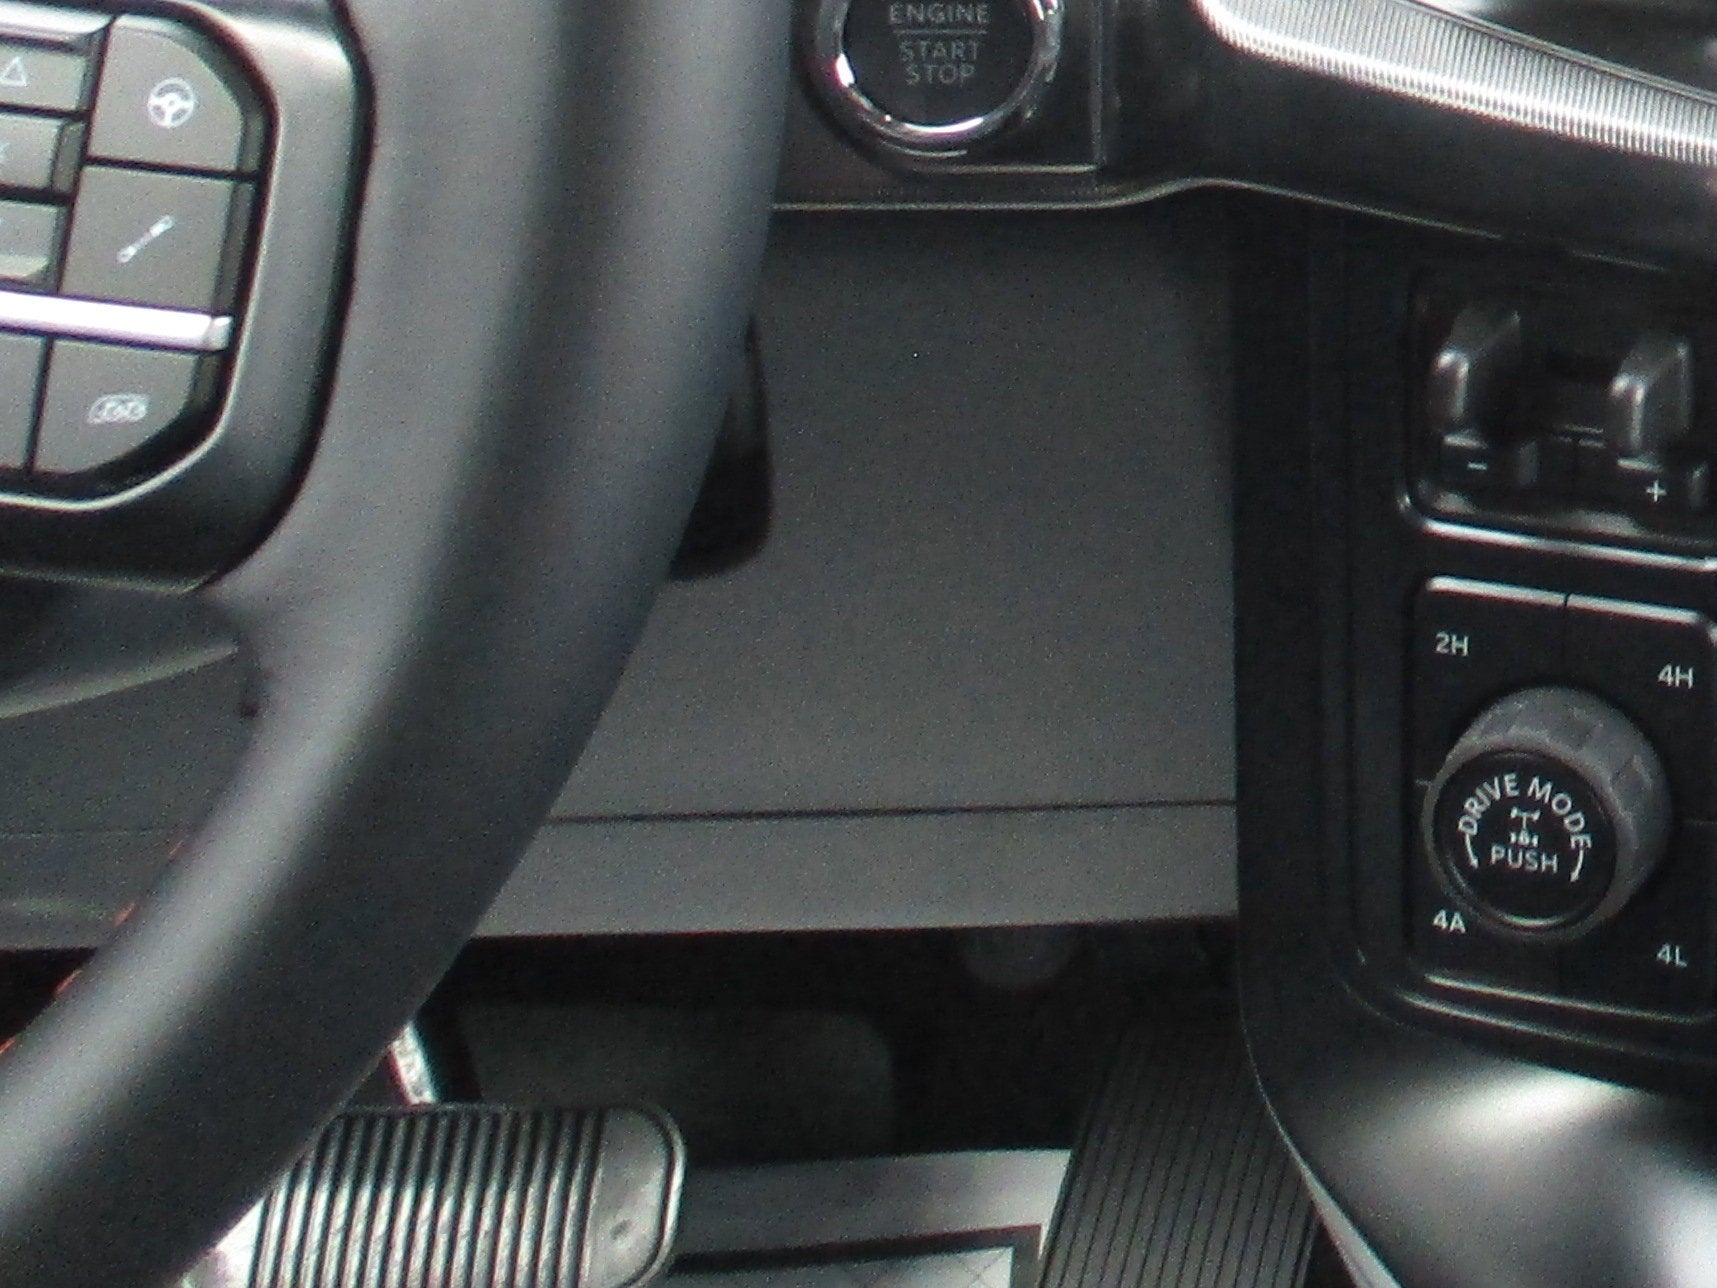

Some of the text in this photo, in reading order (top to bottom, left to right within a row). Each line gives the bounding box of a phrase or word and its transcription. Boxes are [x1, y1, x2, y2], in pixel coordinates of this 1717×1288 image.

[889, 2, 990, 25] ENGINE
[899, 40, 978, 62] START
[905, 64, 975, 86] STOP
[1434, 632, 1470, 658] 2H
[1657, 664, 1695, 690] 4H
[1458, 773, 1592, 849] DRIVE MODE
[1490, 844, 1558, 873] PUSH
[1432, 908, 1467, 935] 4A
[1655, 943, 1690, 970] 4L
